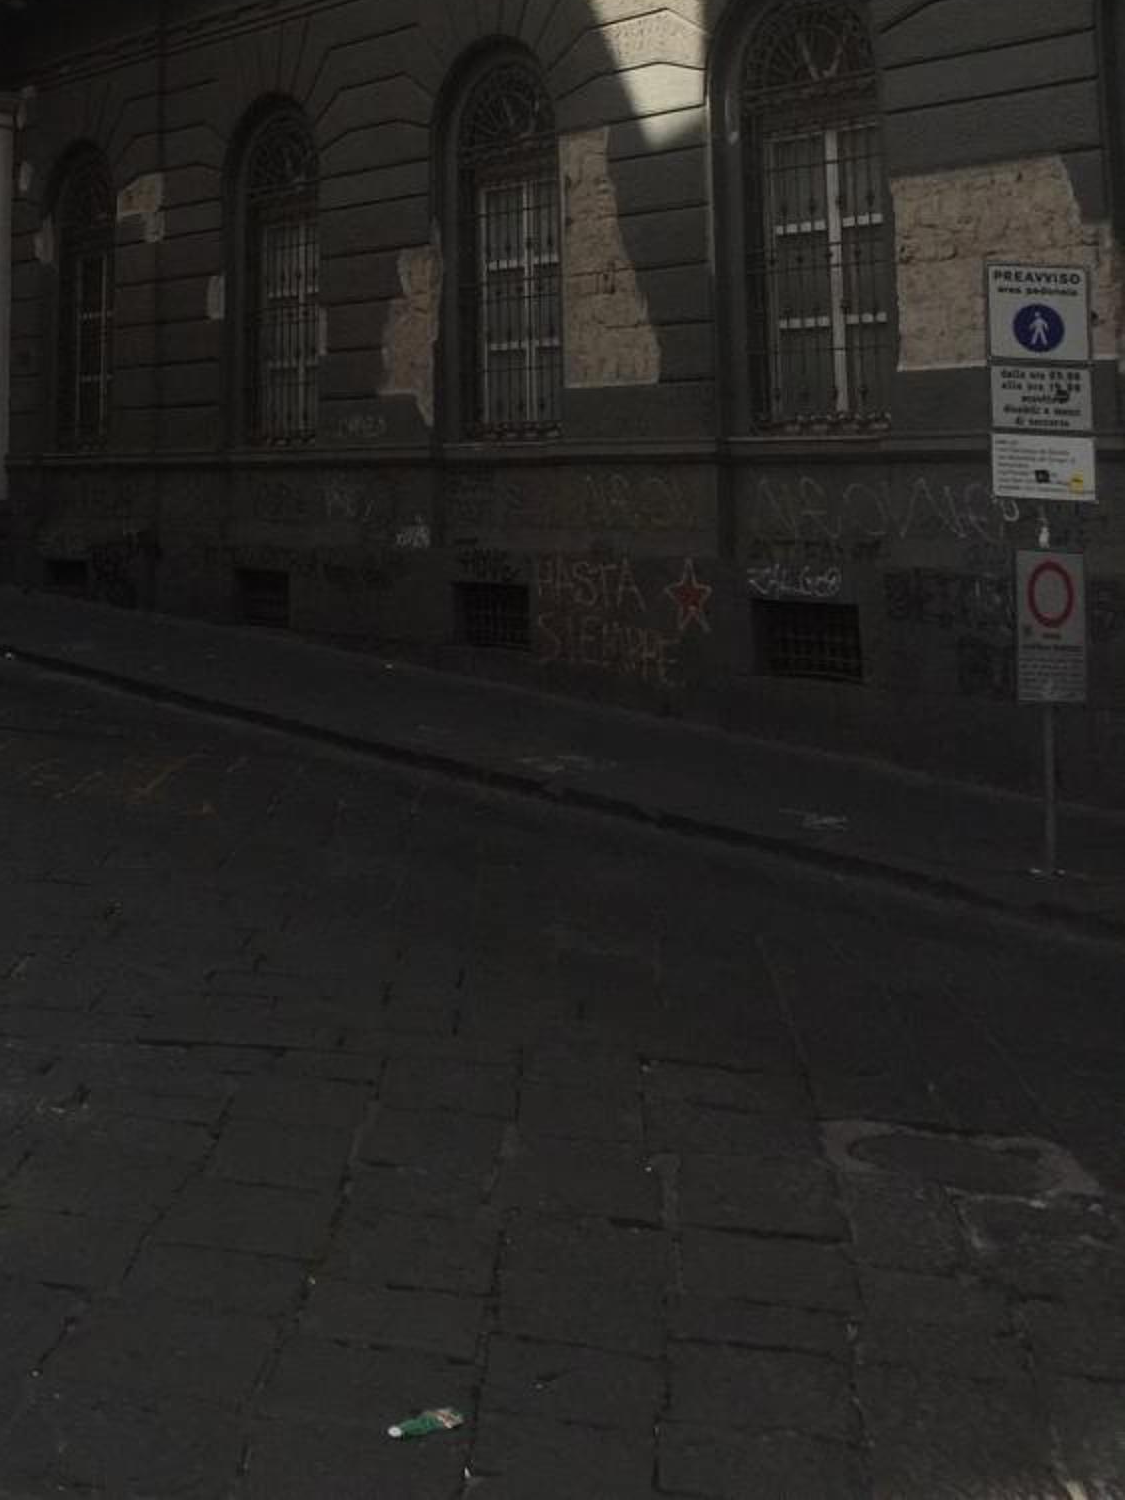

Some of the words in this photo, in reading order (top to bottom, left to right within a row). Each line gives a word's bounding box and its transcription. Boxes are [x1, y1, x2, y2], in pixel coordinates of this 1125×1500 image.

[994, 270, 1080, 284] PREAVVISO
[1001, 380, 1022, 390] alle
[538, 553, 646, 612] HASTA
